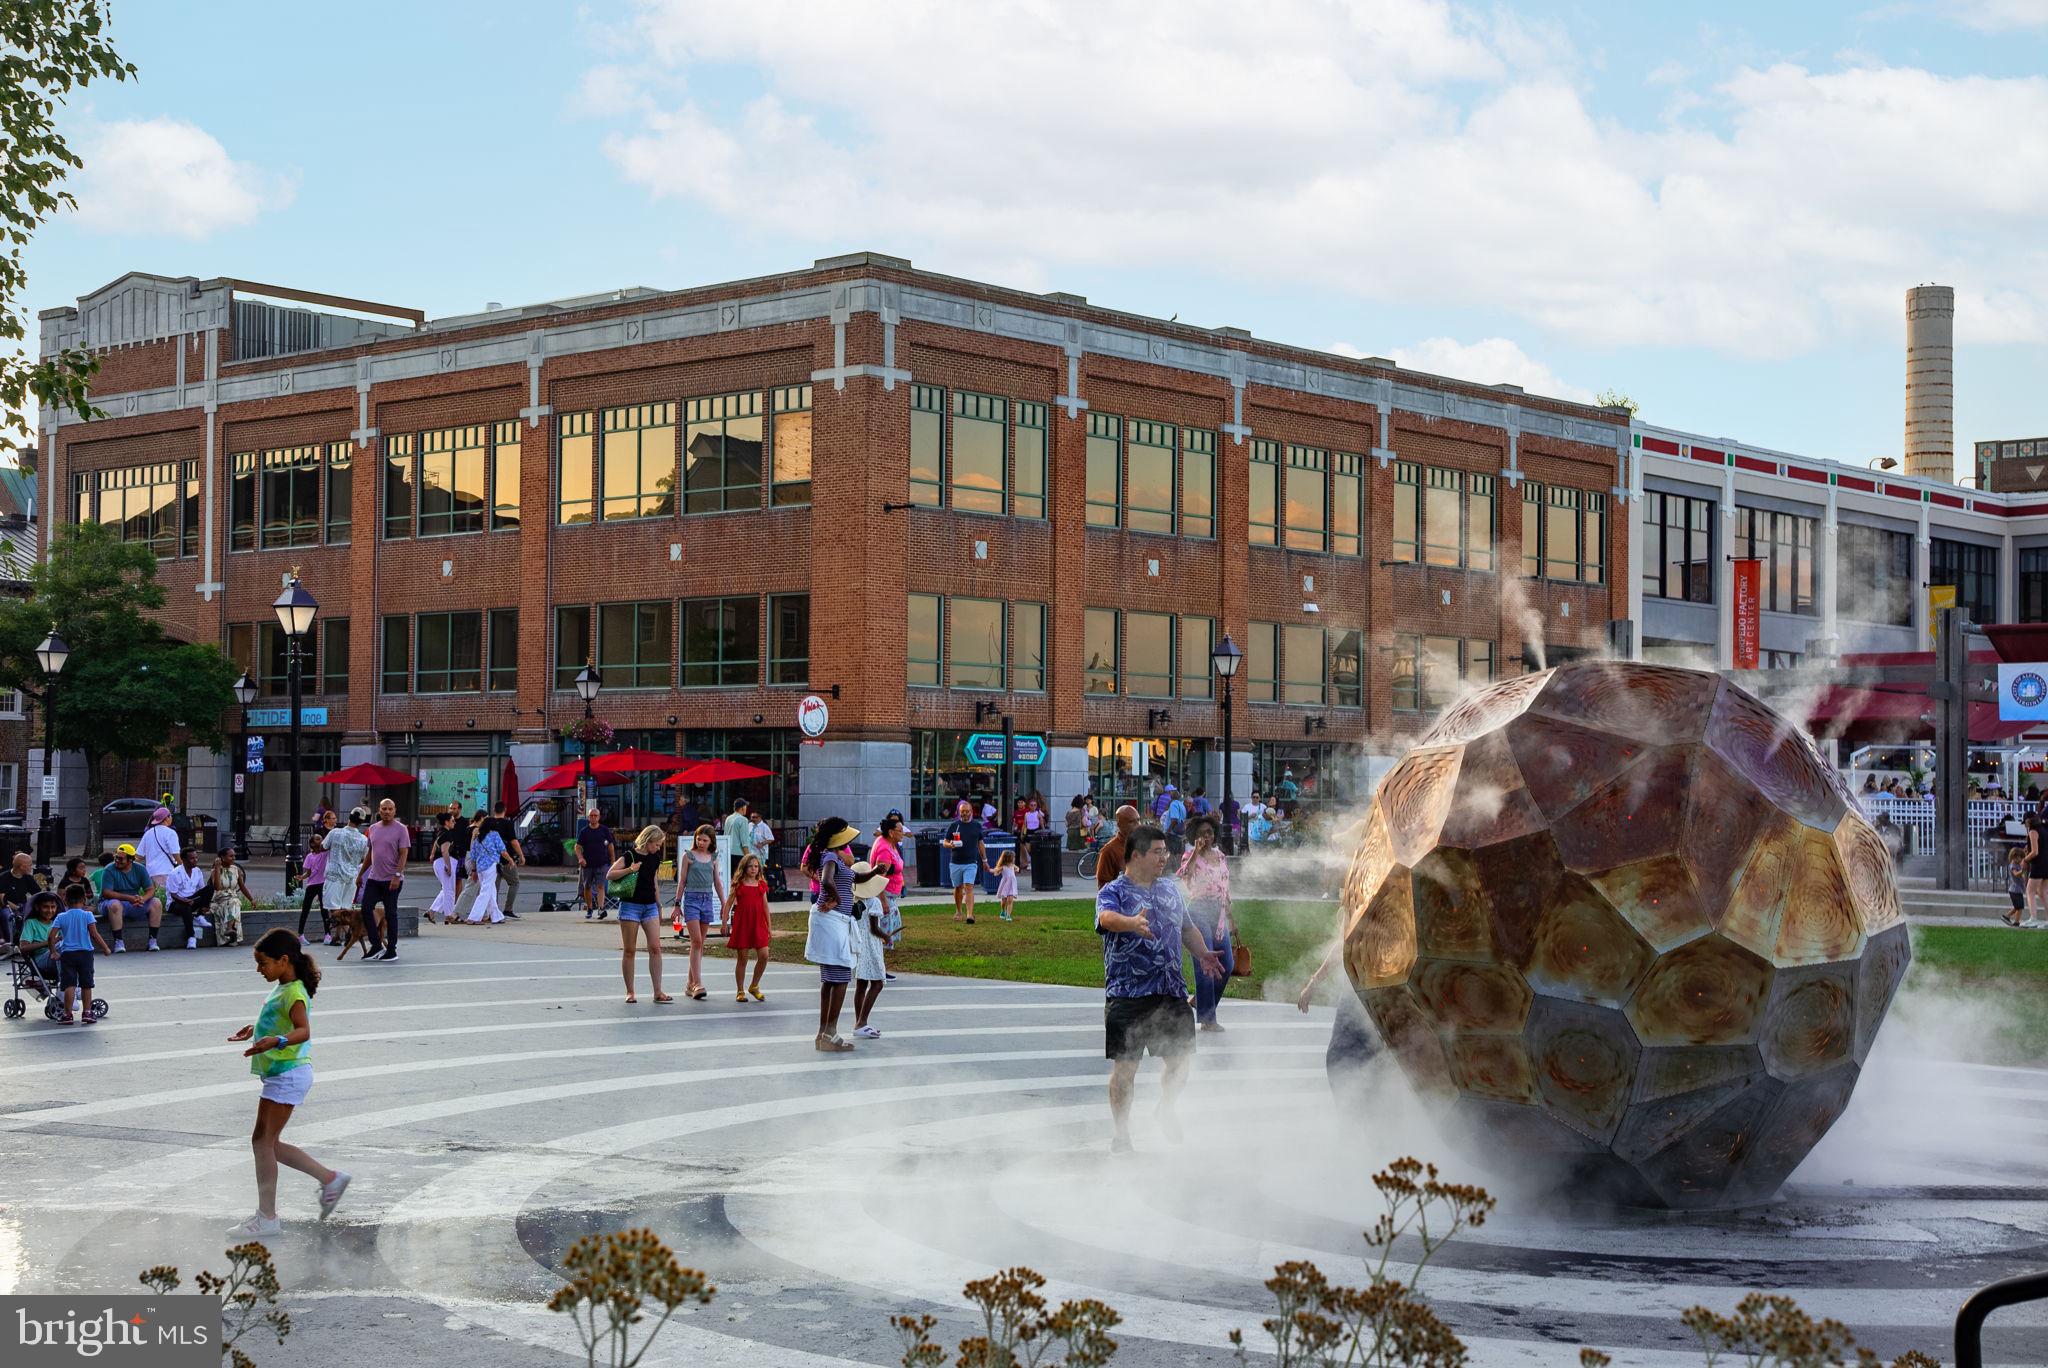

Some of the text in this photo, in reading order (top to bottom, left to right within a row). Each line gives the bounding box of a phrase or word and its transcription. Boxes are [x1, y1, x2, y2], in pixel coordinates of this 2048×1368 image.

[1738, 575, 1748, 660] TORPEDO FACTORY
[1746, 597, 1755, 660] ART CENTER
[247, 735, 264, 746] ALX
[980, 738, 1003, 746] Waterfront
[247, 758, 264, 769] ALX
